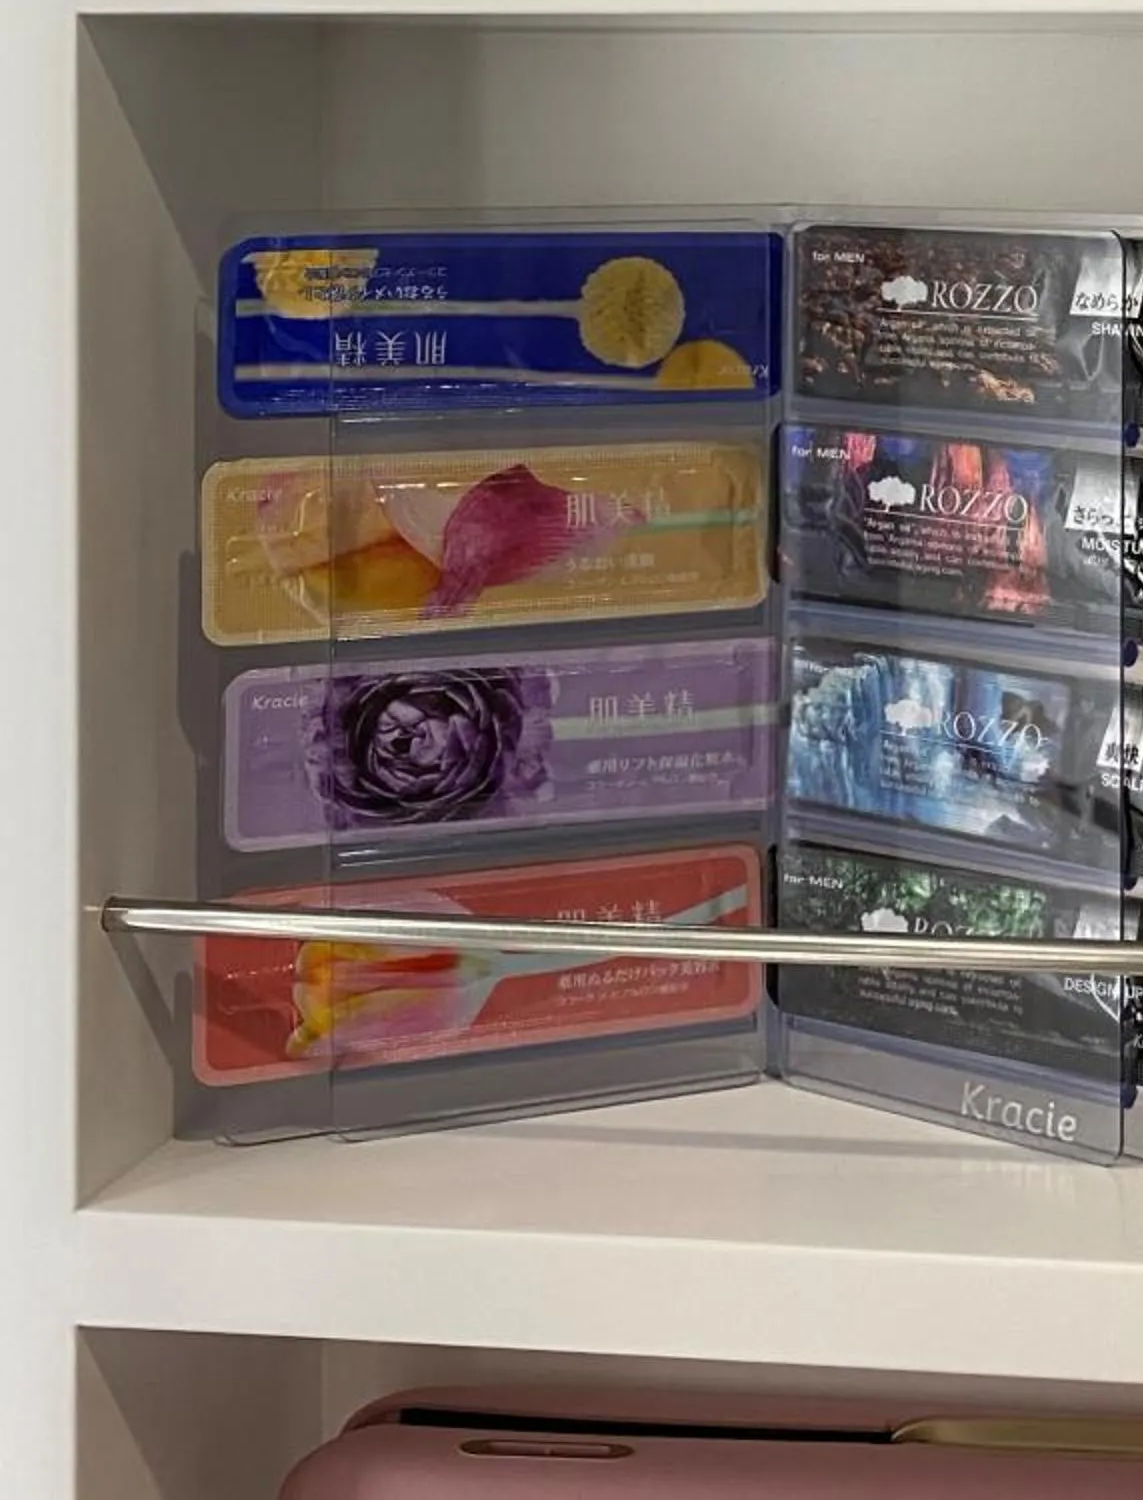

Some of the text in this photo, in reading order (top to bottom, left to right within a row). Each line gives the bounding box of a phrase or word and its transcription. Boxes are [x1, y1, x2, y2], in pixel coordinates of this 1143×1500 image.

[833, 251, 865, 263] MEN
[931, 278, 1038, 314] ROZZO
[334, 330, 447, 368] 肌美精
[817, 446, 851, 461] MEN
[919, 483, 1028, 523] ROZZO
[808, 874, 844, 890] MEN
[1063, 977, 1120, 999] DESIGN
[960, 1080, 1078, 1143] Kracie
